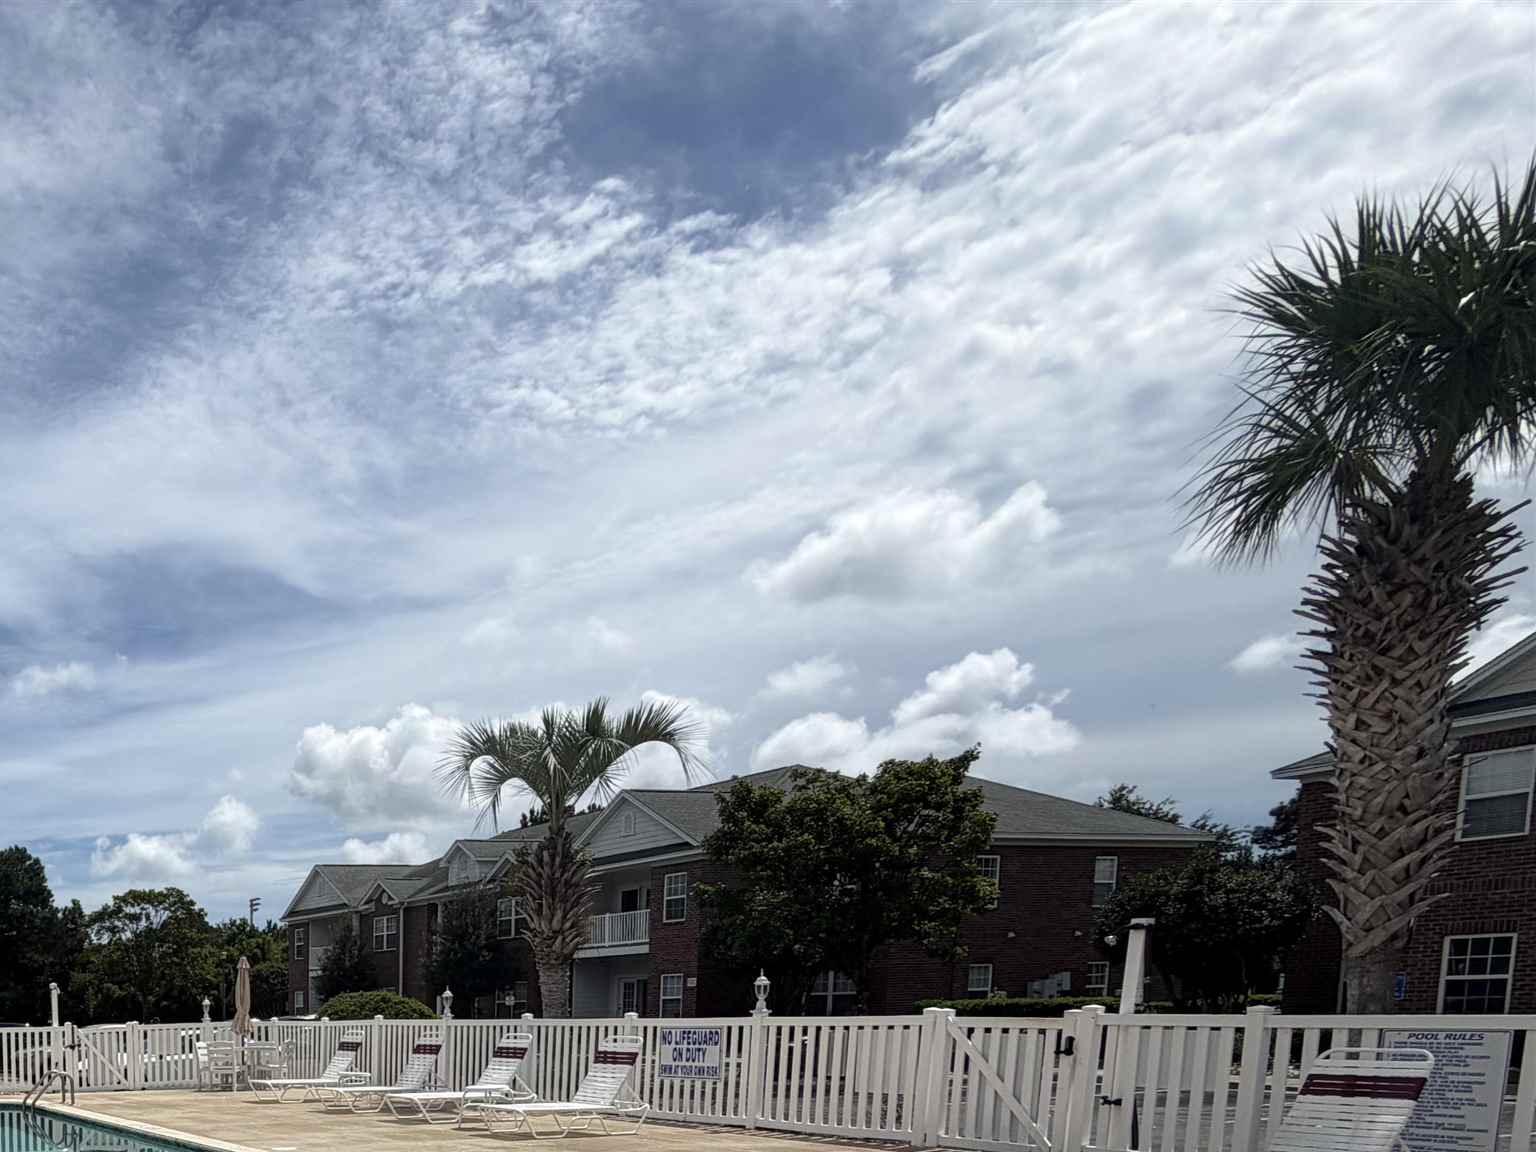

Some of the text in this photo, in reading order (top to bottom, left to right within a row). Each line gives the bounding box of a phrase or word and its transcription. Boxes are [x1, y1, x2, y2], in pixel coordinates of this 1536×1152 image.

[662, 1030, 720, 1046] NO LIFEGUARD
[1407, 1033, 1485, 1041] POOL RULES
[672, 1047, 707, 1063] ON DUTY
